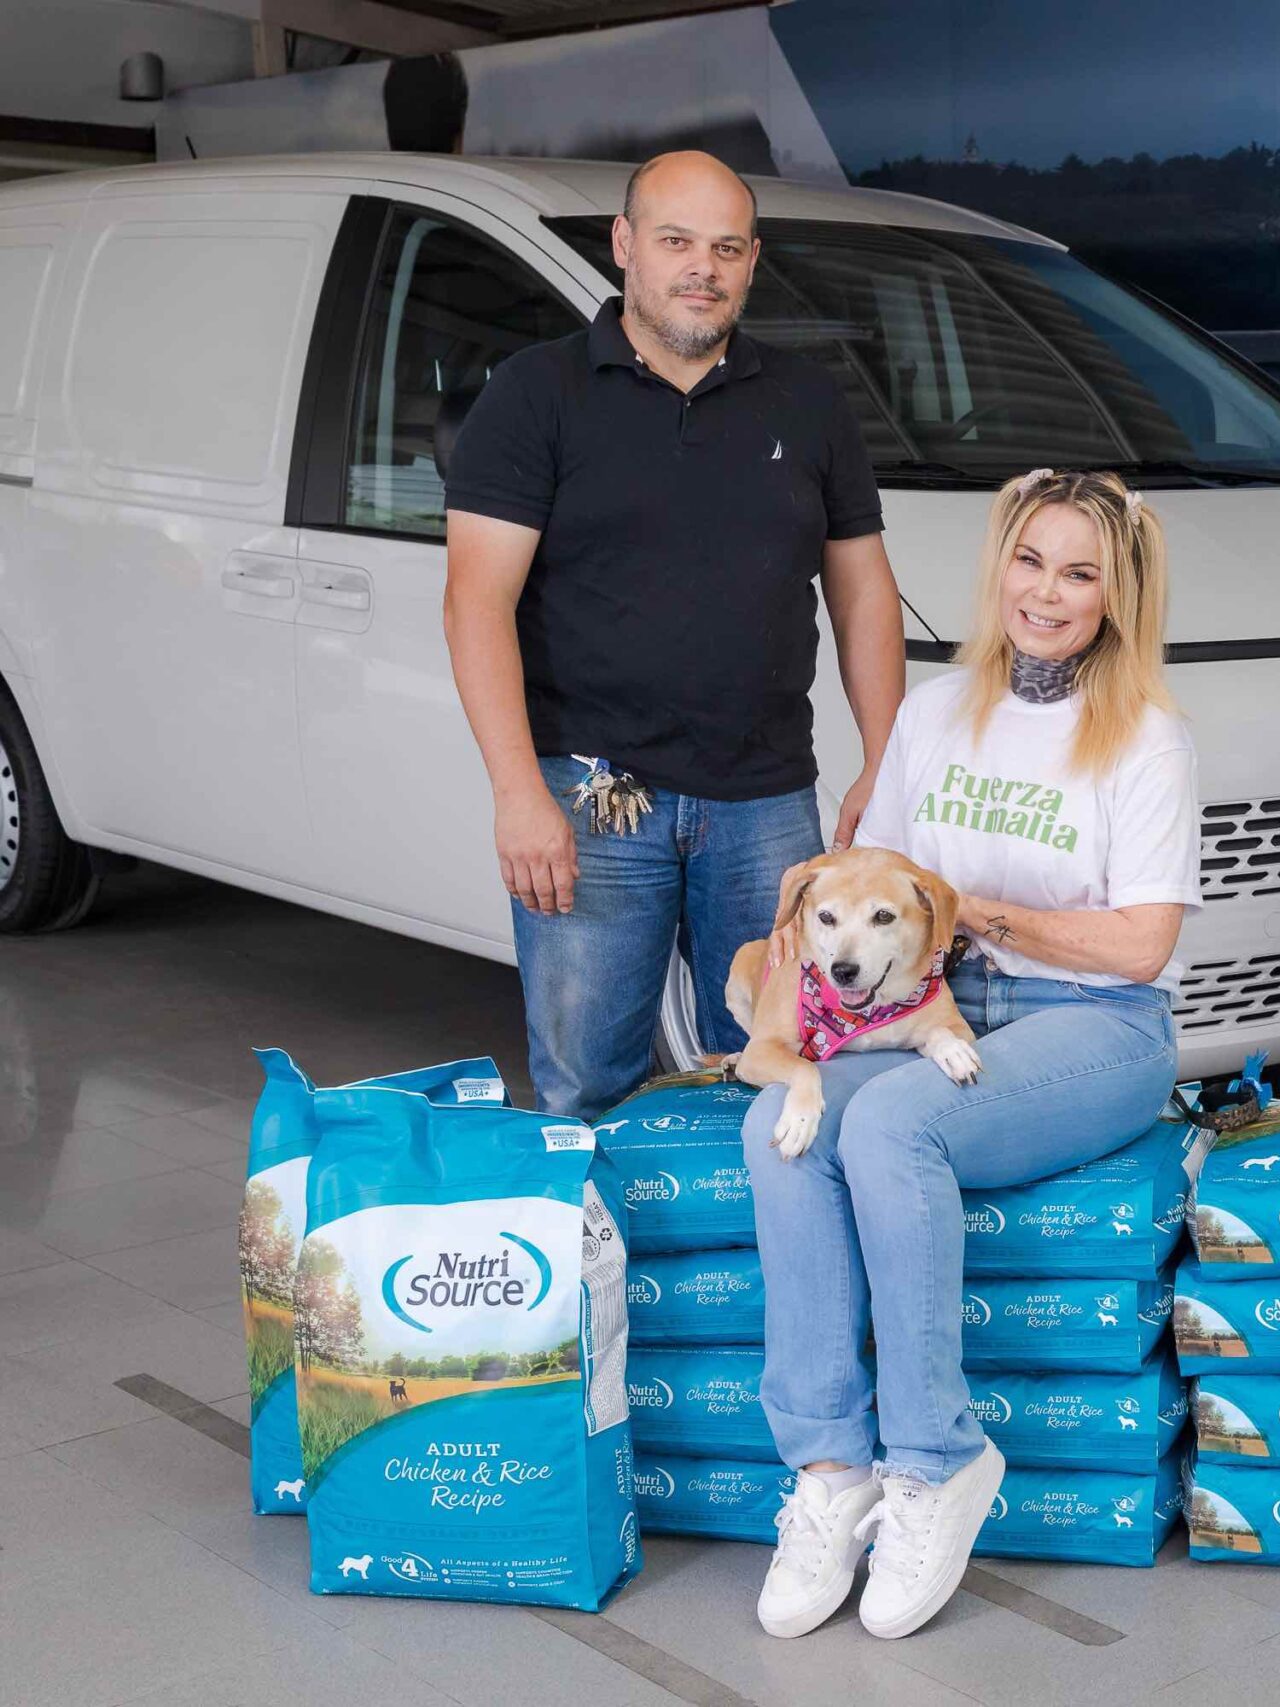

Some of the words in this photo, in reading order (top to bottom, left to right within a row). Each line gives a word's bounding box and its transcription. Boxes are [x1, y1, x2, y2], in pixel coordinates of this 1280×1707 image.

[940, 763, 1064, 816] Fuerza
[913, 792, 1079, 854] Animalia
[467, 1089, 484, 1098] USA
[557, 1139, 575, 1148] USA
[713, 1168, 748, 1176] ADULT
[635, 1178, 664, 1190] Nutri
[692, 1176, 732, 1191] Chicken
[733, 1178, 744, 1189] &
[626, 1188, 670, 1200] Source
[714, 1189, 748, 1203] Recipe
[1041, 1204, 1077, 1212] ADULT
[1018, 1212, 1062, 1225] Chicken
[1064, 1214, 1073, 1225] &
[1074, 1213, 1098, 1225] Rice
[964, 1220, 995, 1233] urce
[1041, 1225, 1077, 1238] Recipe
[434, 1250, 509, 1280] Nutri
[695, 1272, 730, 1280] ADULT
[406, 1274, 524, 1308] Source
[674, 1281, 714, 1294] Chicken
[716, 1282, 726, 1293] &
[727, 1279, 752, 1291] Rice
[696, 1293, 731, 1306] Recipe
[1026, 1295, 1062, 1303] ADULT
[1004, 1303, 1046, 1316] Chicken
[1048, 1305, 1057, 1316] &
[1059, 1303, 1084, 1315] Rice
[1027, 1316, 1062, 1329] Recipe
[628, 1384, 658, 1396] Nutri
[707, 1381, 741, 1389] ADULT
[628, 1395, 663, 1407] ource
[686, 1389, 726, 1401] Chicken
[727, 1392, 738, 1402] &
[738, 1390, 761, 1402] Rice
[1047, 1395, 1083, 1404] ADULT
[707, 1402, 742, 1416] Recipe
[1025, 1403, 1067, 1416] Chicken
[1069, 1405, 1079, 1417] &
[1080, 1404, 1104, 1417] Rice
[1046, 1416, 1082, 1430] Recipe
[426, 1443, 500, 1457] ADULT
[385, 1458, 468, 1483] Chicken
[472, 1463, 496, 1486] &
[499, 1460, 553, 1482] Rice
[709, 1471, 743, 1480] ADULT
[635, 1485, 665, 1496] urce
[687, 1480, 727, 1492] Chicken
[728, 1482, 739, 1493] &
[740, 1481, 765, 1492] Rice
[431, 1486, 506, 1515] Recipe
[708, 1493, 743, 1506] Recipe
[1043, 1493, 1079, 1501] ADULT
[1021, 1500, 1062, 1514] Chicken
[1063, 1502, 1073, 1515] &
[1075, 1502, 1100, 1514] Rice
[1042, 1514, 1078, 1528] Recipe
[381, 1555, 402, 1564] Good
[441, 1558, 453, 1566] All
[456, 1558, 489, 1567] Aspects
[491, 1559, 501, 1567] of
[511, 1557, 547, 1567] Healthy
[549, 1555, 568, 1564] Life
[401, 1558, 419, 1577] 4
[420, 1571, 438, 1579] Life
